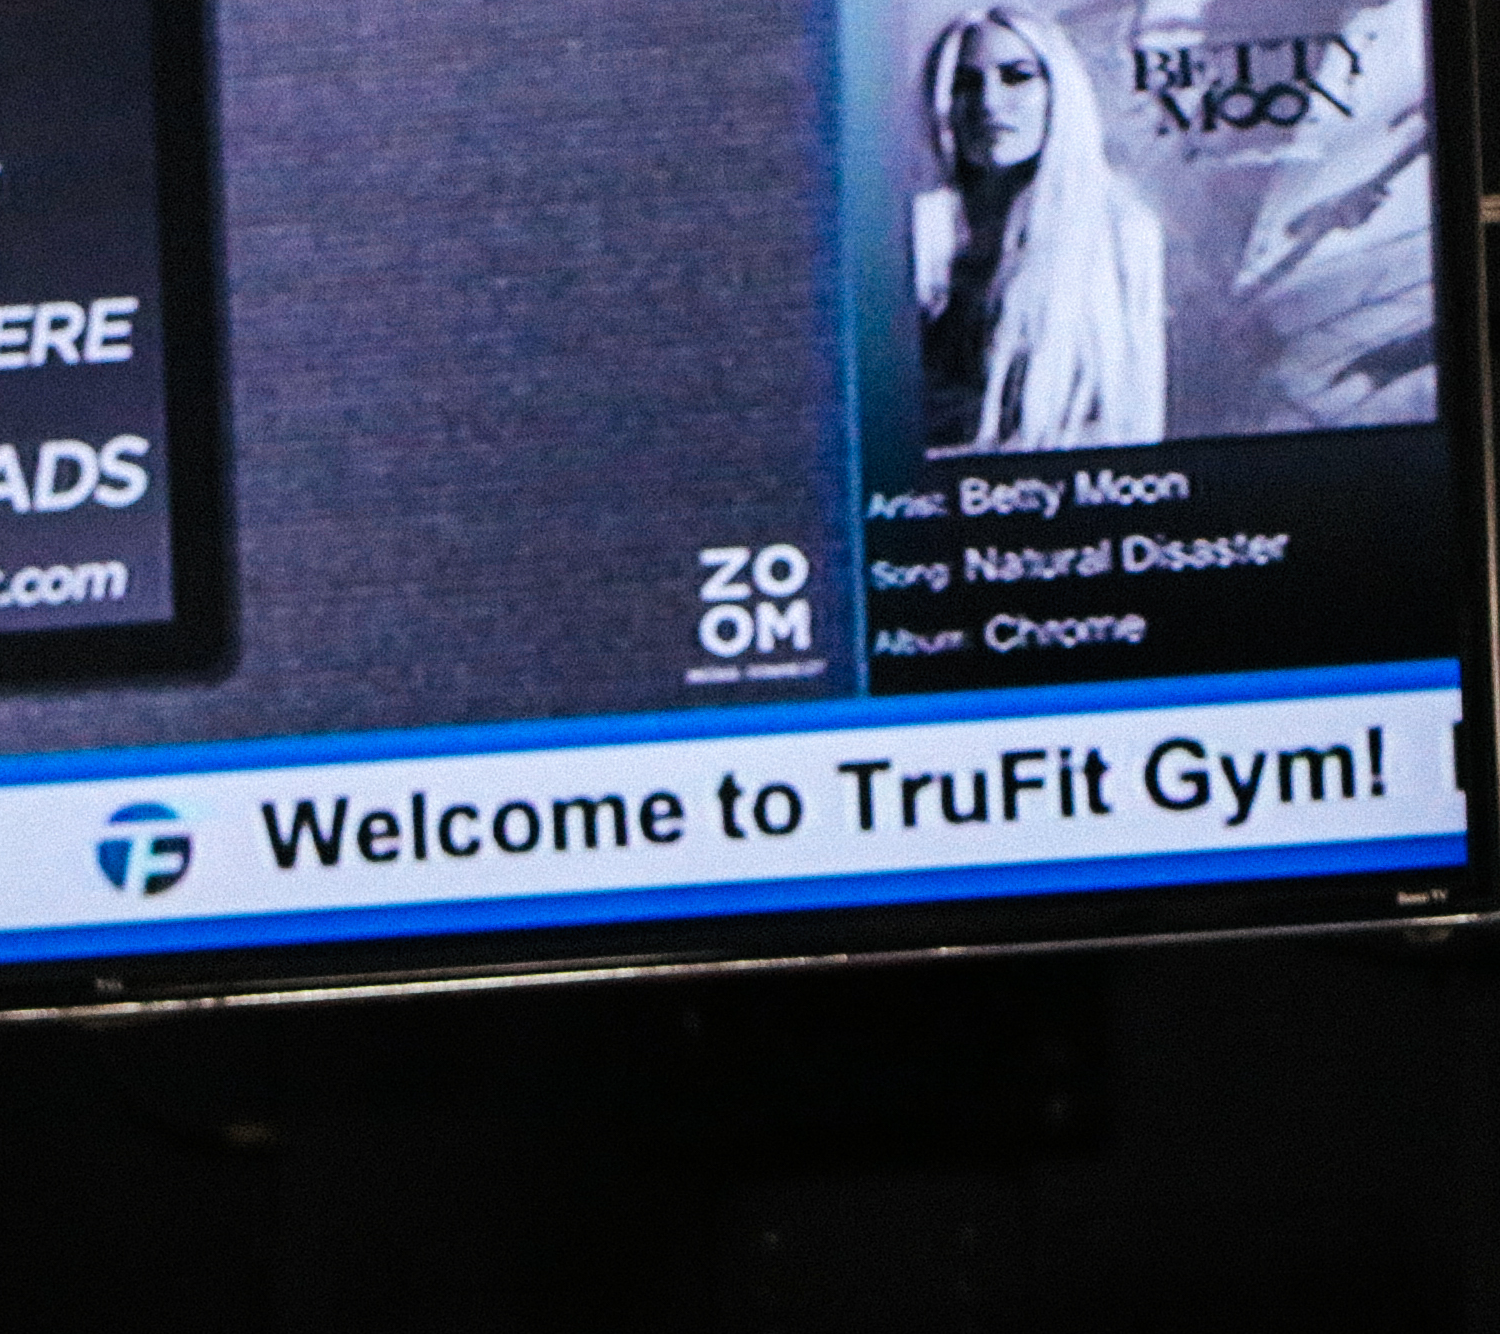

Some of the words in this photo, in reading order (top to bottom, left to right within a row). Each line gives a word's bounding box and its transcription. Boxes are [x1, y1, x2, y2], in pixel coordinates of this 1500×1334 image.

[958, 476, 1066, 520] Betty
[1073, 468, 1190, 506] Moon
[962, 537, 1112, 582] Natural
[1121, 533, 1290, 574] Disaster
[983, 613, 1148, 653] Chrome
[260, 790, 685, 870] Welcome
[716, 772, 804, 839] to
[837, 745, 1113, 831] TruFit
[1142, 725, 1386, 827] Gym!
